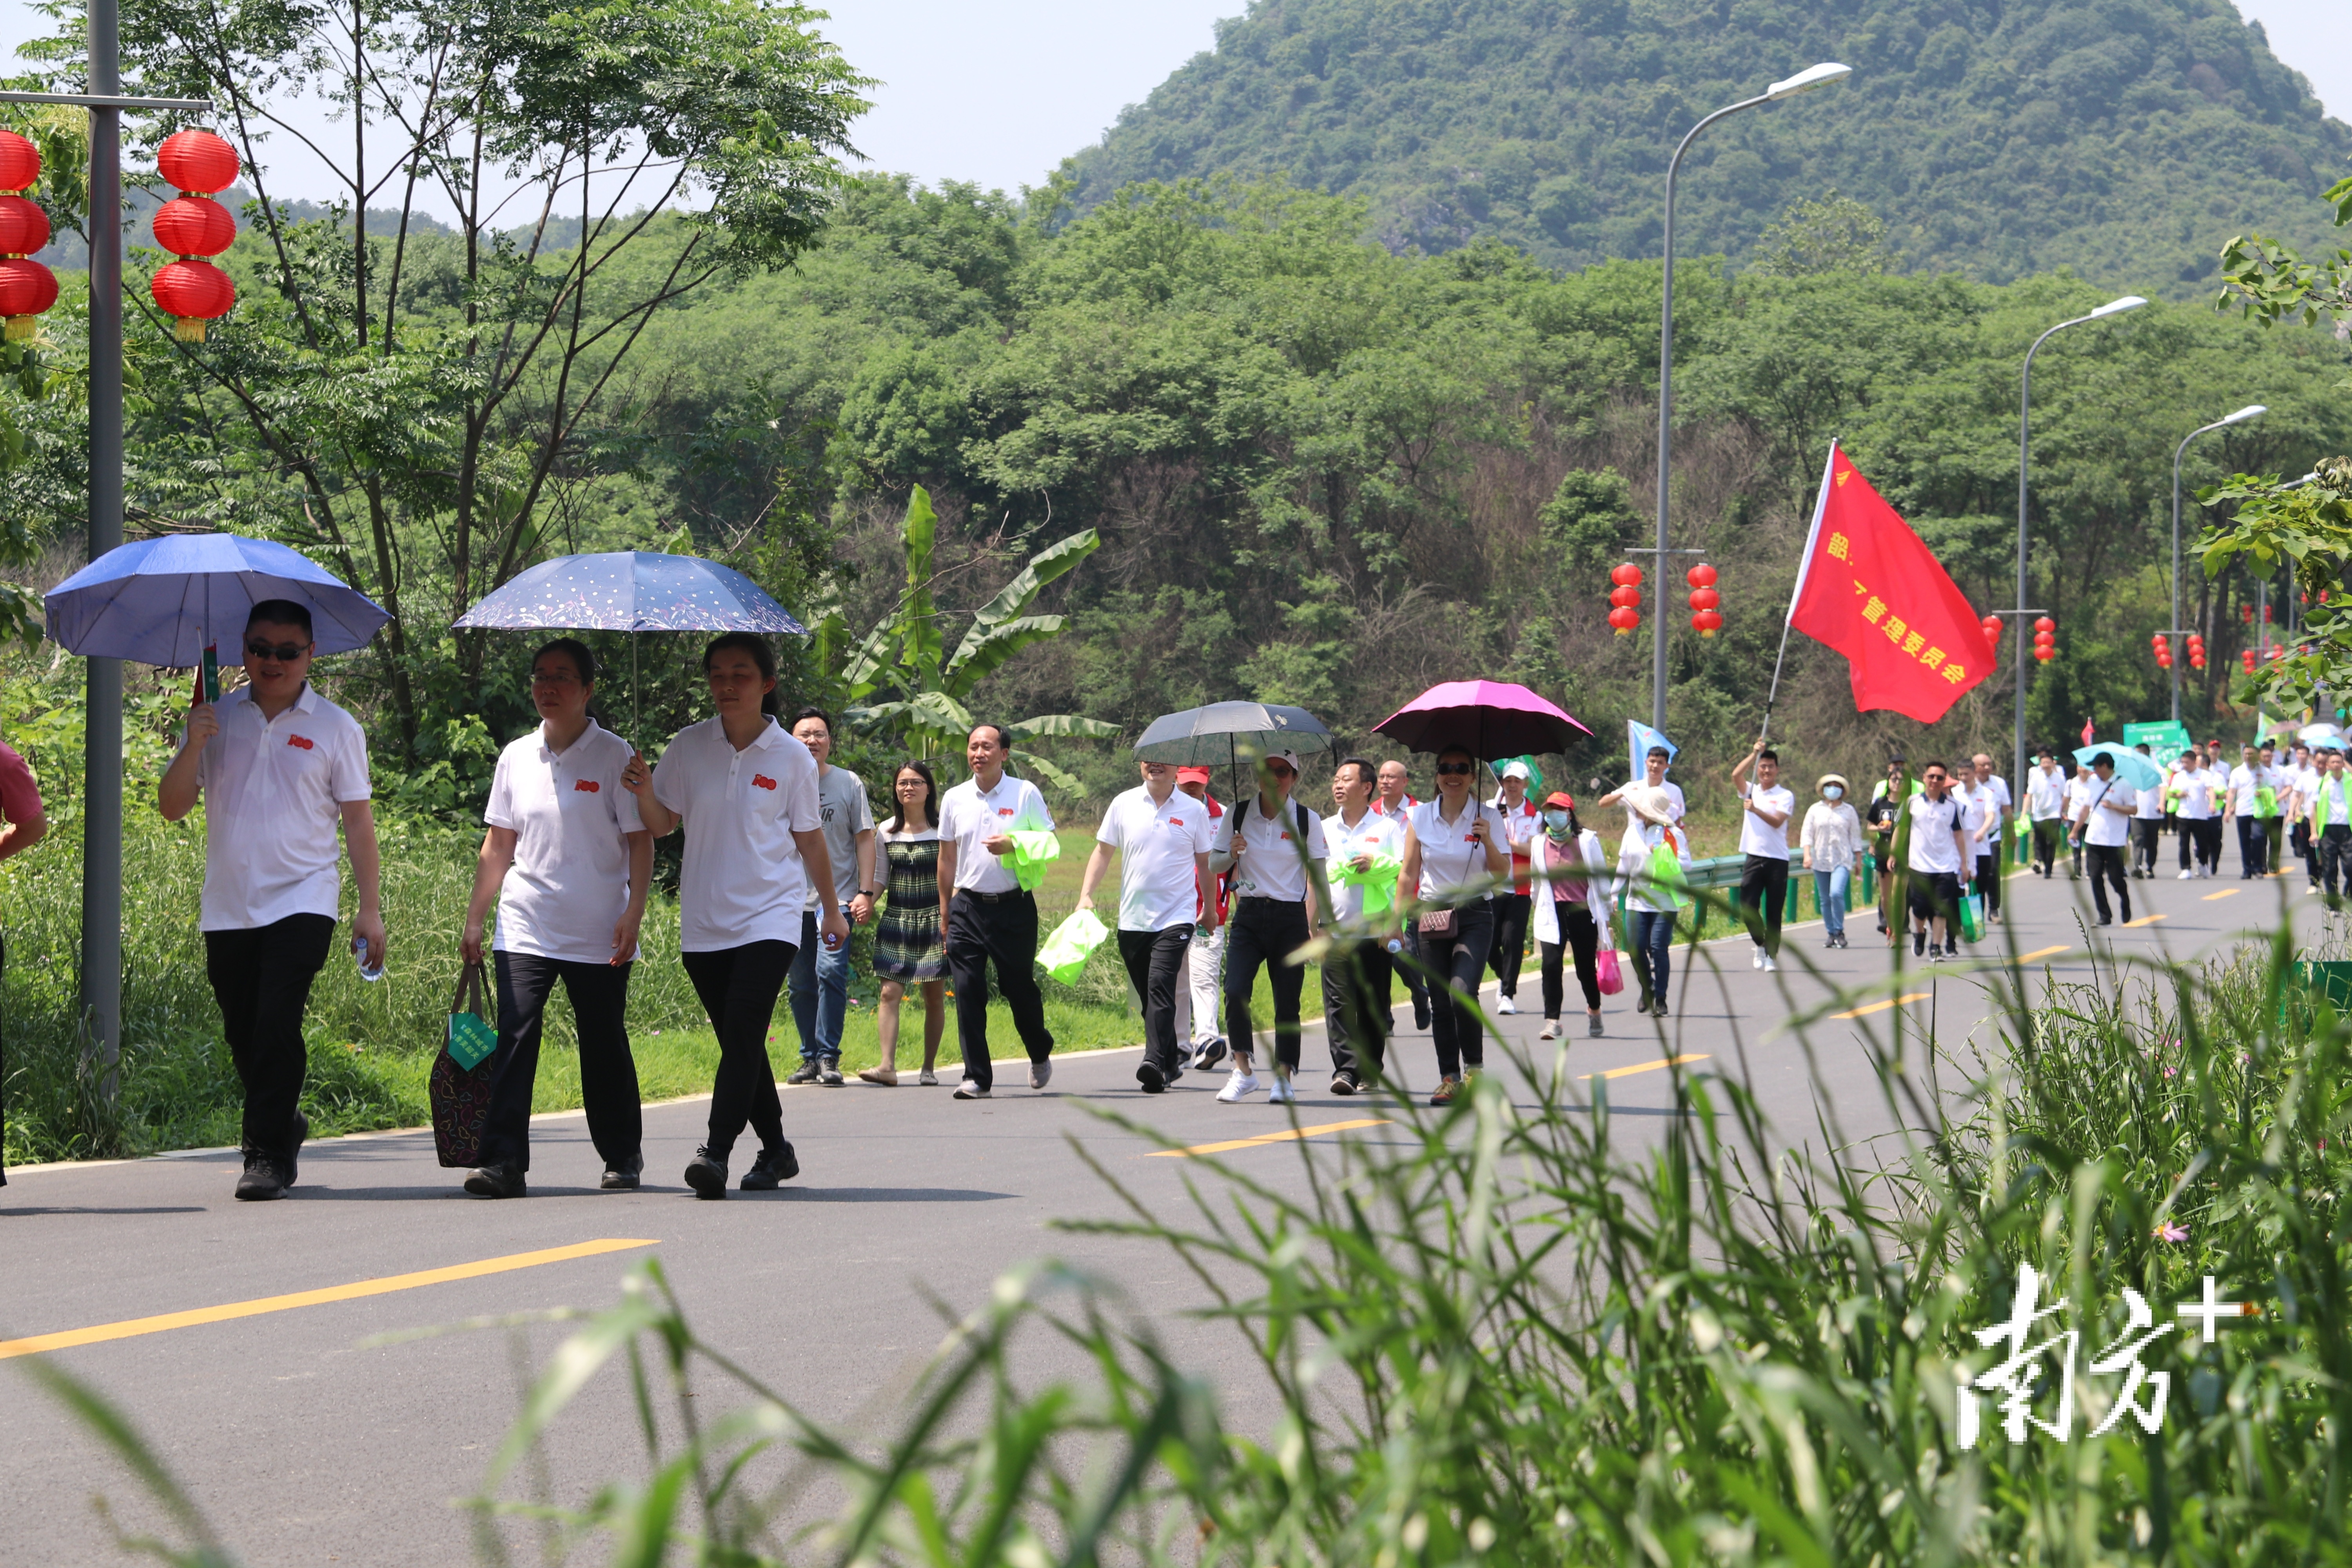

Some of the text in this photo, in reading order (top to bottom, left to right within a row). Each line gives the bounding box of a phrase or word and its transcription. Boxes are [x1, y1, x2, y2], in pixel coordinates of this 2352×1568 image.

[1827, 531, 1967, 684] 韶管理委员会
